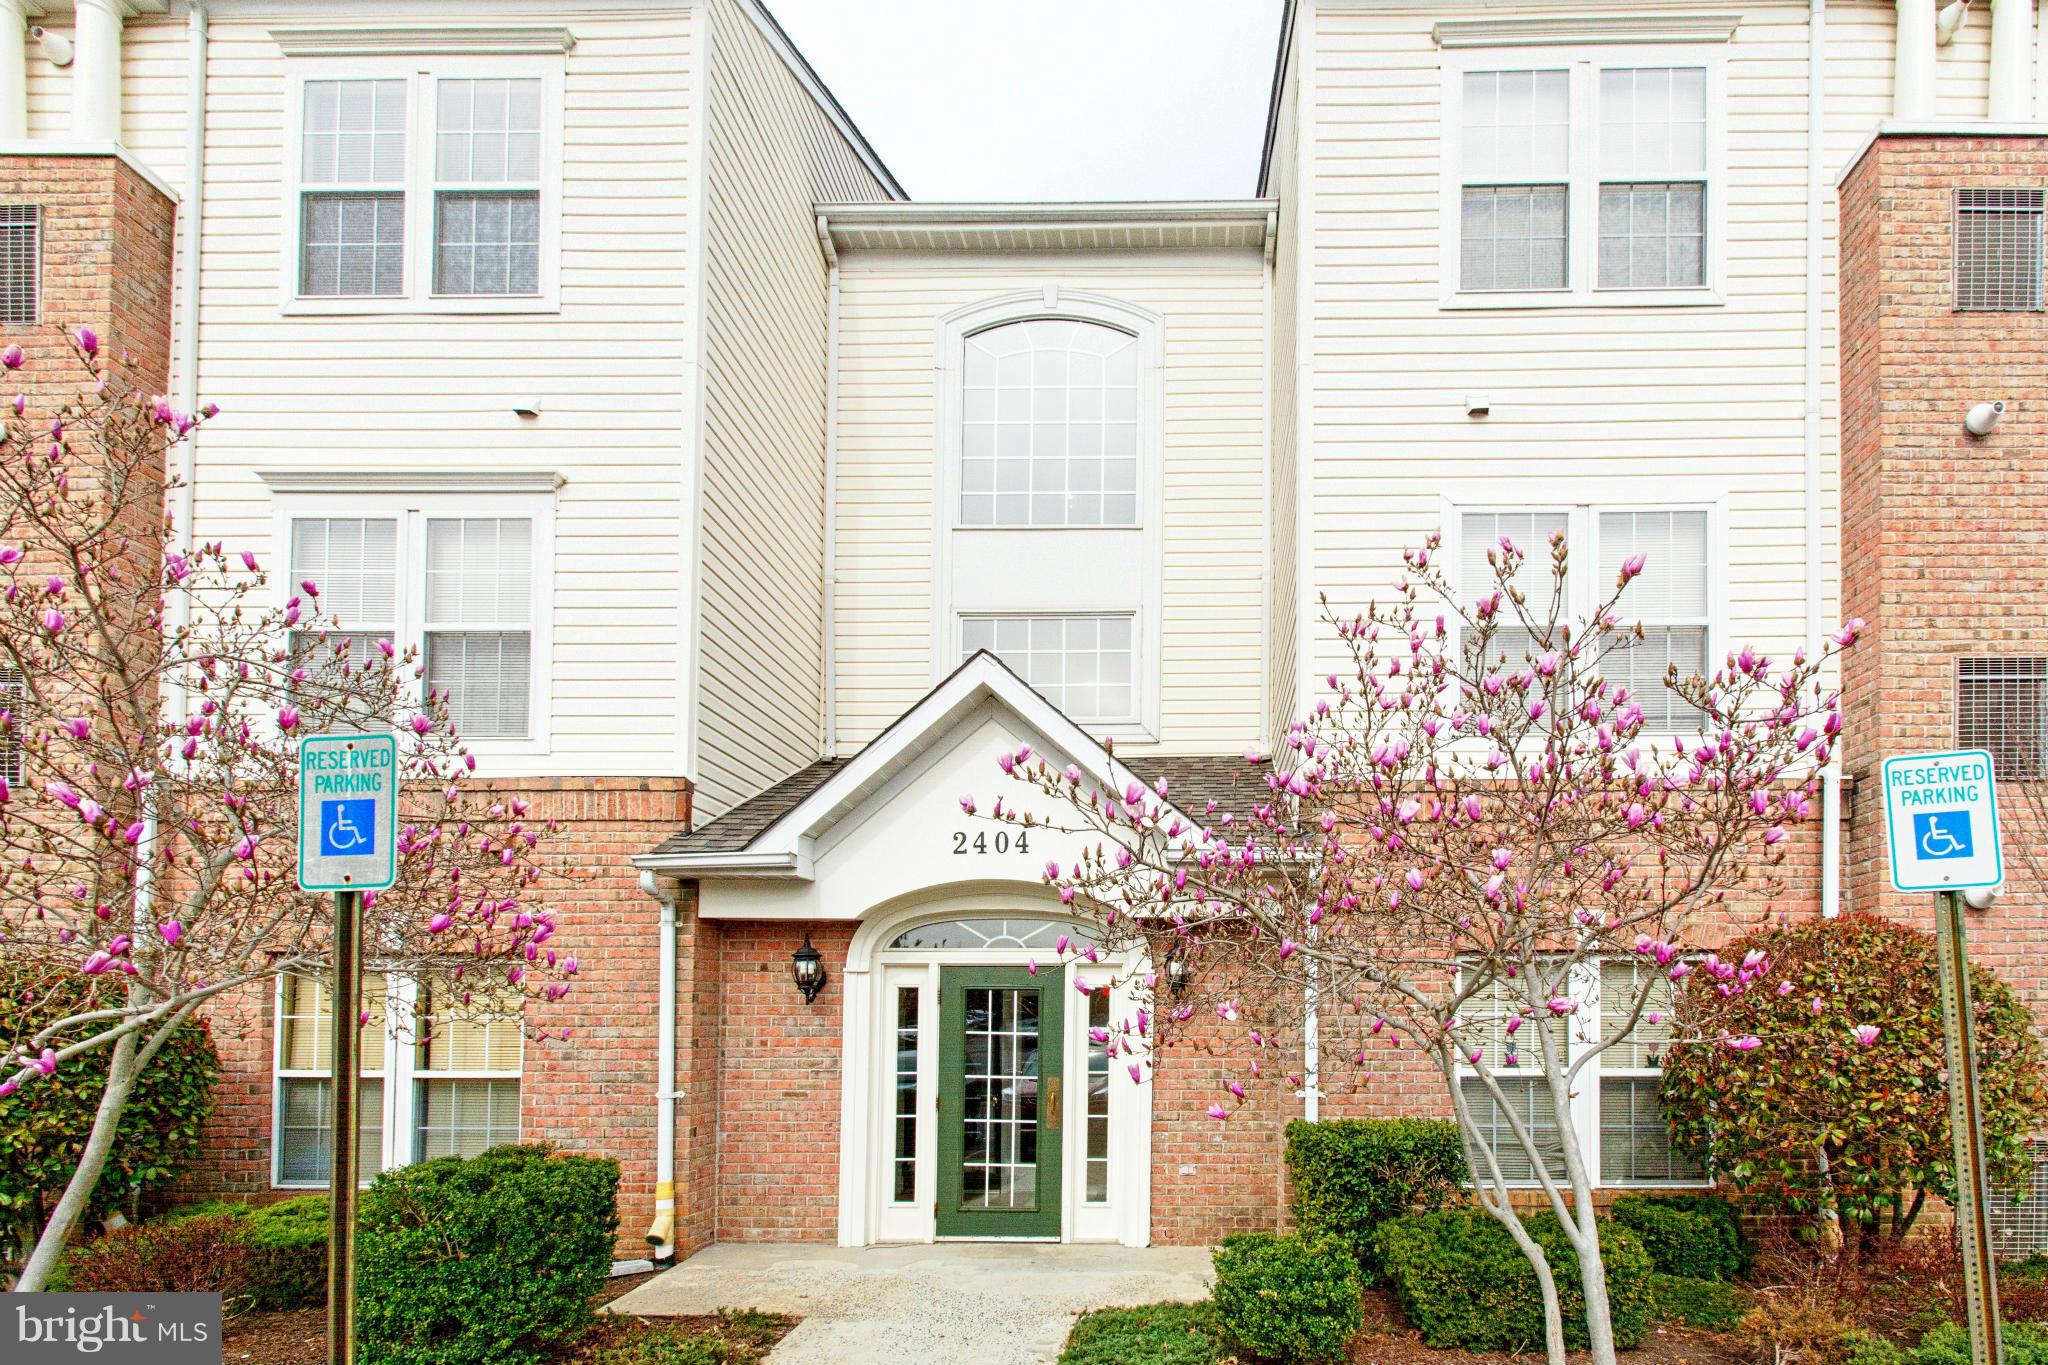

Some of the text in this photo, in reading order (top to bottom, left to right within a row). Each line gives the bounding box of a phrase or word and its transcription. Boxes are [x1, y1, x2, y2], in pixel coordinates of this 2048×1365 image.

[306, 748, 391, 770] RESERVED
[315, 773, 382, 794] PARKING
[1891, 764, 1985, 786] RESERVED
[1901, 785, 1979, 807] PARKING
[953, 831, 1029, 854] 2404
